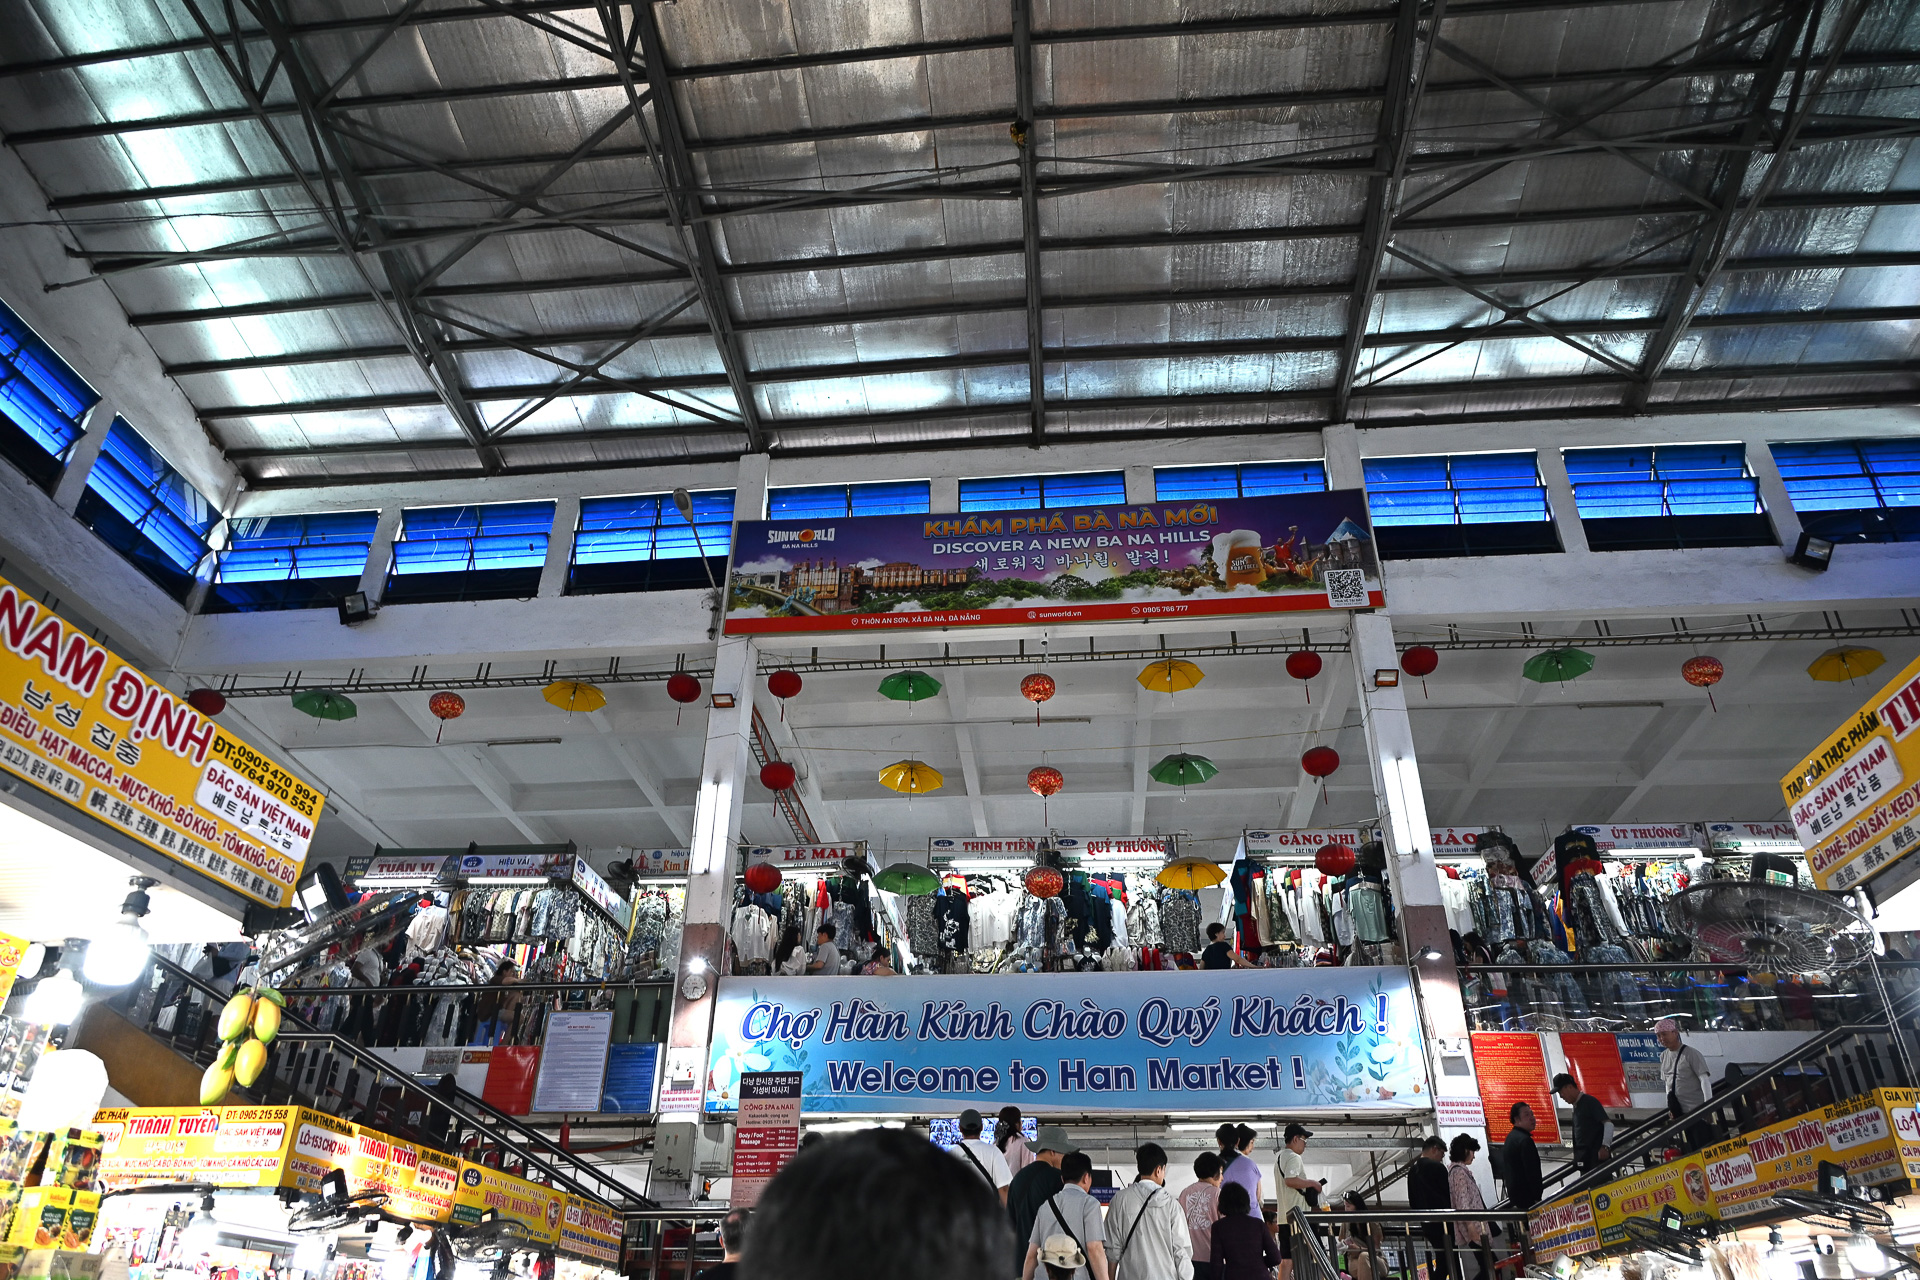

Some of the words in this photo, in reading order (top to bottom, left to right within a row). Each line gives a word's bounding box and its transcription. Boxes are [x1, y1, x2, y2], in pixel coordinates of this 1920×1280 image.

[923, 515, 1003, 538] KHÁM
[1010, 512, 1068, 536] PHÁ
[1073, 509, 1113, 533] BÀ
[1118, 507, 1160, 530] NÀ
[1164, 503, 1218, 526] MỚI
[933, 540, 1024, 555] DISCOVER
[1028, 539, 1042, 551] A
[1047, 536, 1091, 550] NEW
[1096, 535, 1123, 548] BA
[1127, 534, 1154, 546] NA
[1159, 530, 1210, 544] HILLS
[974, 554, 1046, 572] 새로워진
[1126, 549, 1169, 566] 발견!
[881, 617, 892, 625] AN
[1039, 610, 1082, 618] sunworld.vn
[0, 588, 106, 694] NAM
[111, 670, 214, 764] ĐỊNH
[1821, 737, 1850, 768] THỰC
[237, 746, 270, 773] 0905
[270, 769, 292, 788] 470
[294, 784, 317, 805] 994
[0, 706, 37, 739] ĐIỀU
[39, 728, 70, 756] HẠT
[67, 746, 113, 784] MACCA
[118, 775, 148, 802] MỰC
[192, 817, 217, 841] KHÔ
[281, 864, 295, 884] BÒ
[233, 759, 264, 785] 0764
[266, 780, 288, 799] 970
[290, 796, 313, 816] 553
[1794, 803, 1815, 827] ĐẶC
[1835, 764, 1861, 793] VIỆT
[1859, 744, 1887, 775] NAM
[212, 791, 253, 825] 베트남
[234, 785, 260, 809] SẢN
[262, 800, 286, 825] VIỆT
[286, 816, 311, 839] NAM
[1810, 801, 1843, 835] 베트남
[1843, 773, 1881, 808] 특산품
[811, 847, 847, 859] MAI
[962, 841, 1002, 855] THỊNH
[1087, 837, 1112, 855] QUÝ
[498, 858, 517, 867] HIỆU
[663, 860, 681, 871] Kim
[486, 868, 510, 877] KIM
[741, 1002, 820, 1048] Chợ
[823, 999, 909, 1043] Hàn
[918, 999, 1014, 1041] Kính
[1023, 997, 1127, 1041] Chào
[1138, 997, 1220, 1047] Quý
[1231, 995, 1365, 1036] Khách
[1376, 992, 1389, 1034] !
[742, 1078, 754, 1086] 다낭
[755, 1077, 773, 1086] 한시장
[775, 1077, 787, 1085] 주변
[828, 1060, 1000, 1093] Welcome
[1009, 1059, 1048, 1092] to
[1059, 1060, 1136, 1091] Han
[1148, 1056, 1281, 1090] Market
[1291, 1056, 1306, 1089] !
[752, 1086, 771, 1095] 가성비
[1883, 1090, 1901, 1102] GIA
[1902, 1091, 1914, 1104] VỊ
[239, 1110, 258, 1120] 0905
[259, 1109, 273, 1119] 215
[274, 1109, 288, 1119] 558
[301, 1111, 312, 1120] GIA
[320, 1115, 335, 1130] THỰC
[1864, 1110, 1881, 1122] NAM
[250, 1125, 266, 1139] VIỆT
[266, 1127, 282, 1136] NAM
[322, 1138, 337, 1157] CHỢ
[1718, 1144, 1732, 1155] THỰC
[1775, 1160, 1792, 1173] 사랑
[1796, 1154, 1813, 1167] 사랑
[466, 1175, 477, 1185] 152
[484, 1175, 498, 1186] GIA
[1610, 1189, 1624, 1198] GIA
[1633, 1178, 1654, 1192] THỰC
[483, 1189, 511, 1210] DIỆU
[1621, 1192, 1649, 1214] CHỊ
